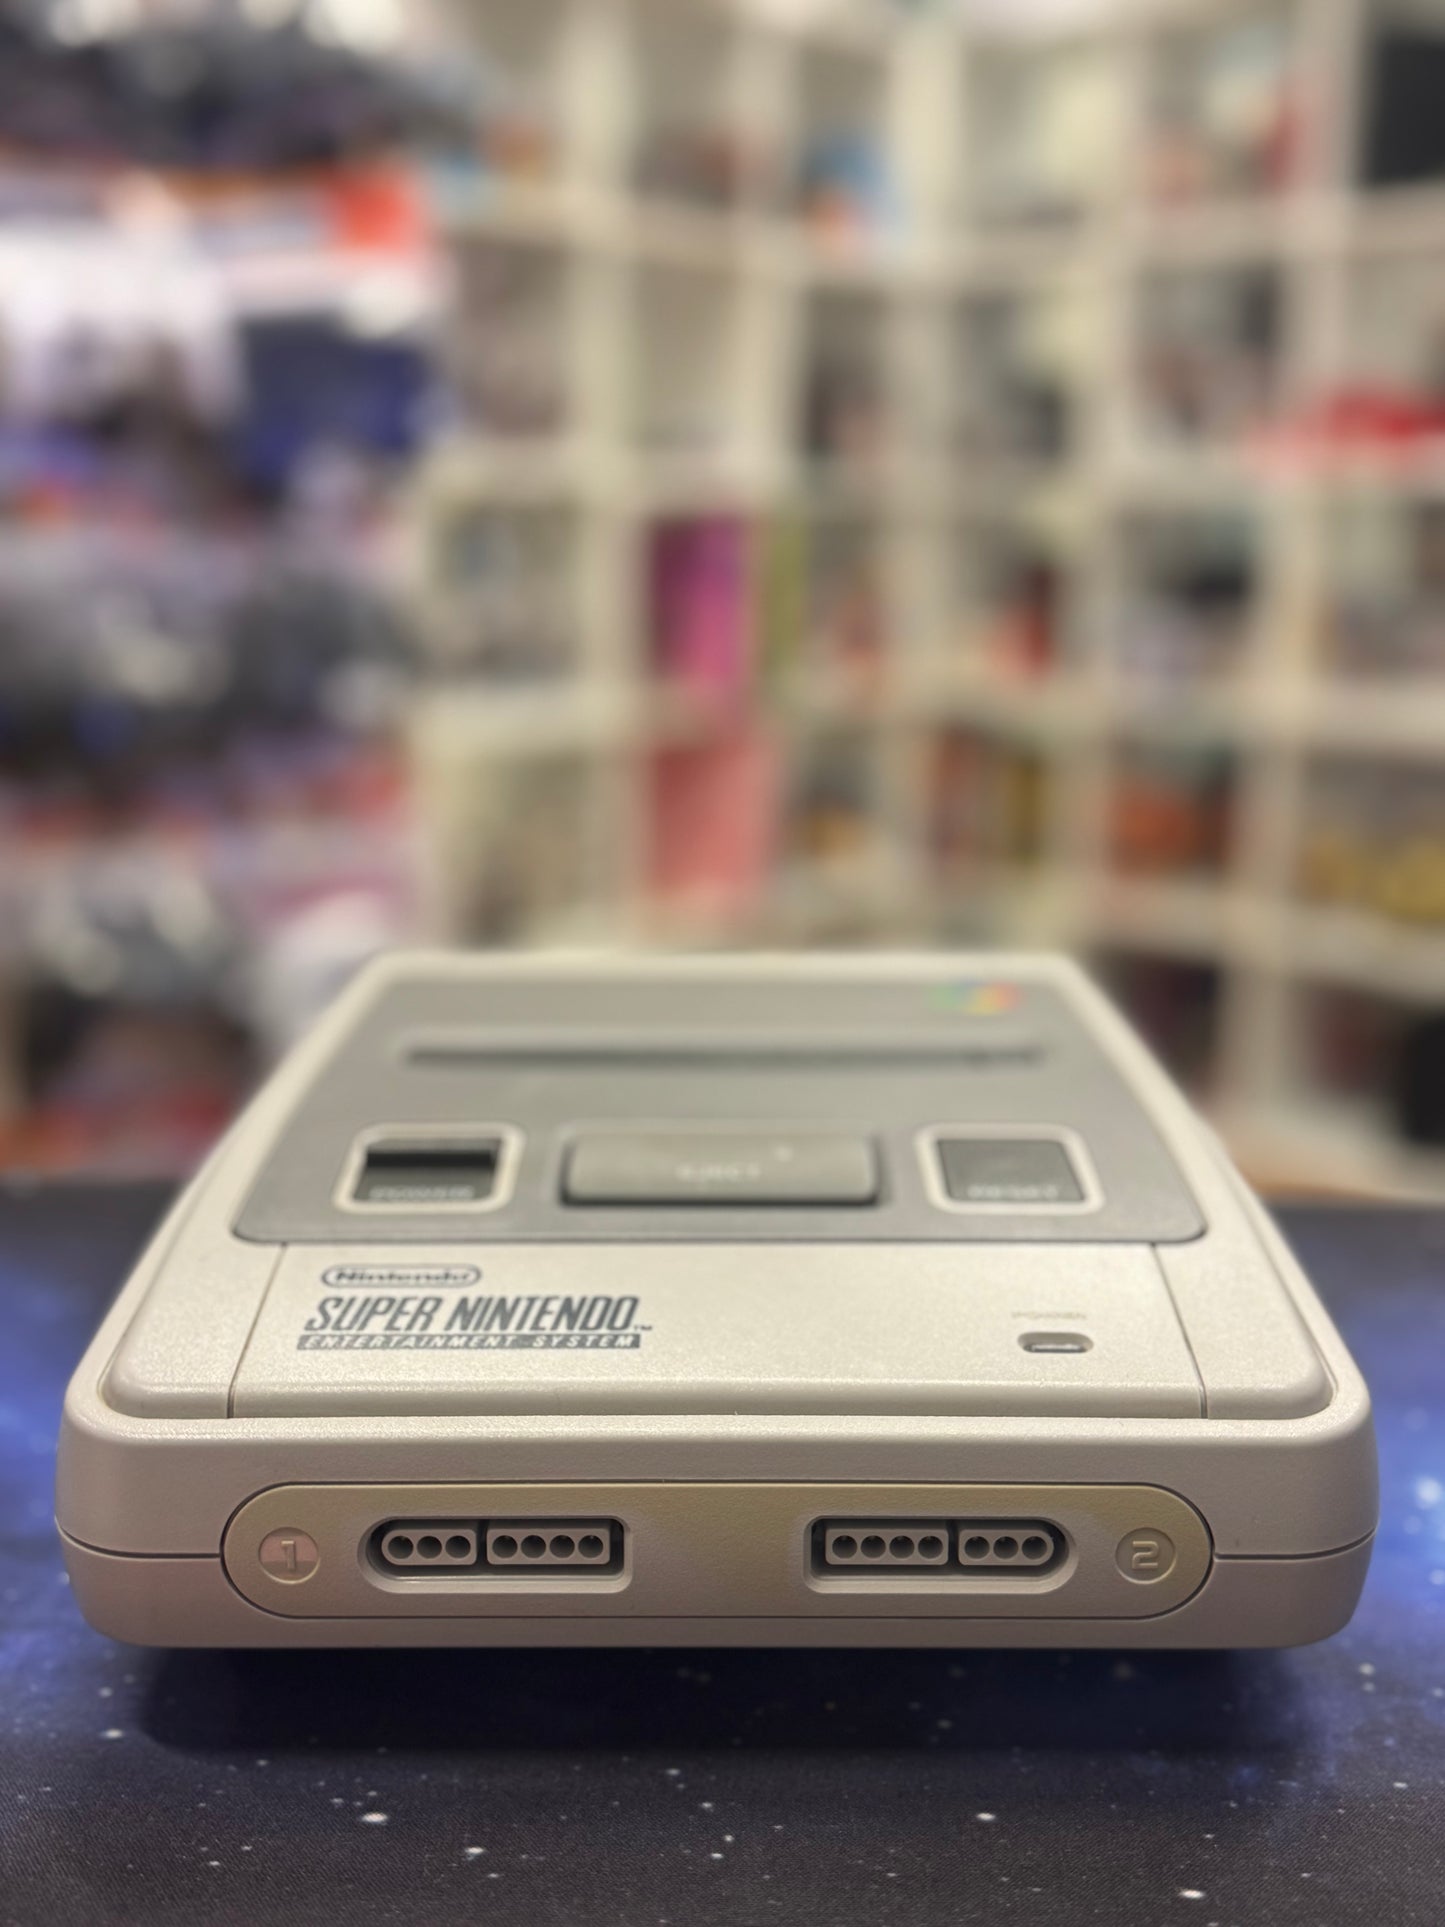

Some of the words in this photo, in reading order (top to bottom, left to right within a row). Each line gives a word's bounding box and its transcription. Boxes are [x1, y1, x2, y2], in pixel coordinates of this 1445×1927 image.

[336, 1267, 470, 1281] Nintendo
[304, 1296, 443, 1331] SUPER
[444, 1296, 640, 1331] NINTENDO
[304, 1335, 518, 1348] ENTERTAINMENT
[532, 1335, 636, 1348] SYSTEM
[281, 1540, 297, 1570] 1
[1132, 1540, 1159, 1570] 2
